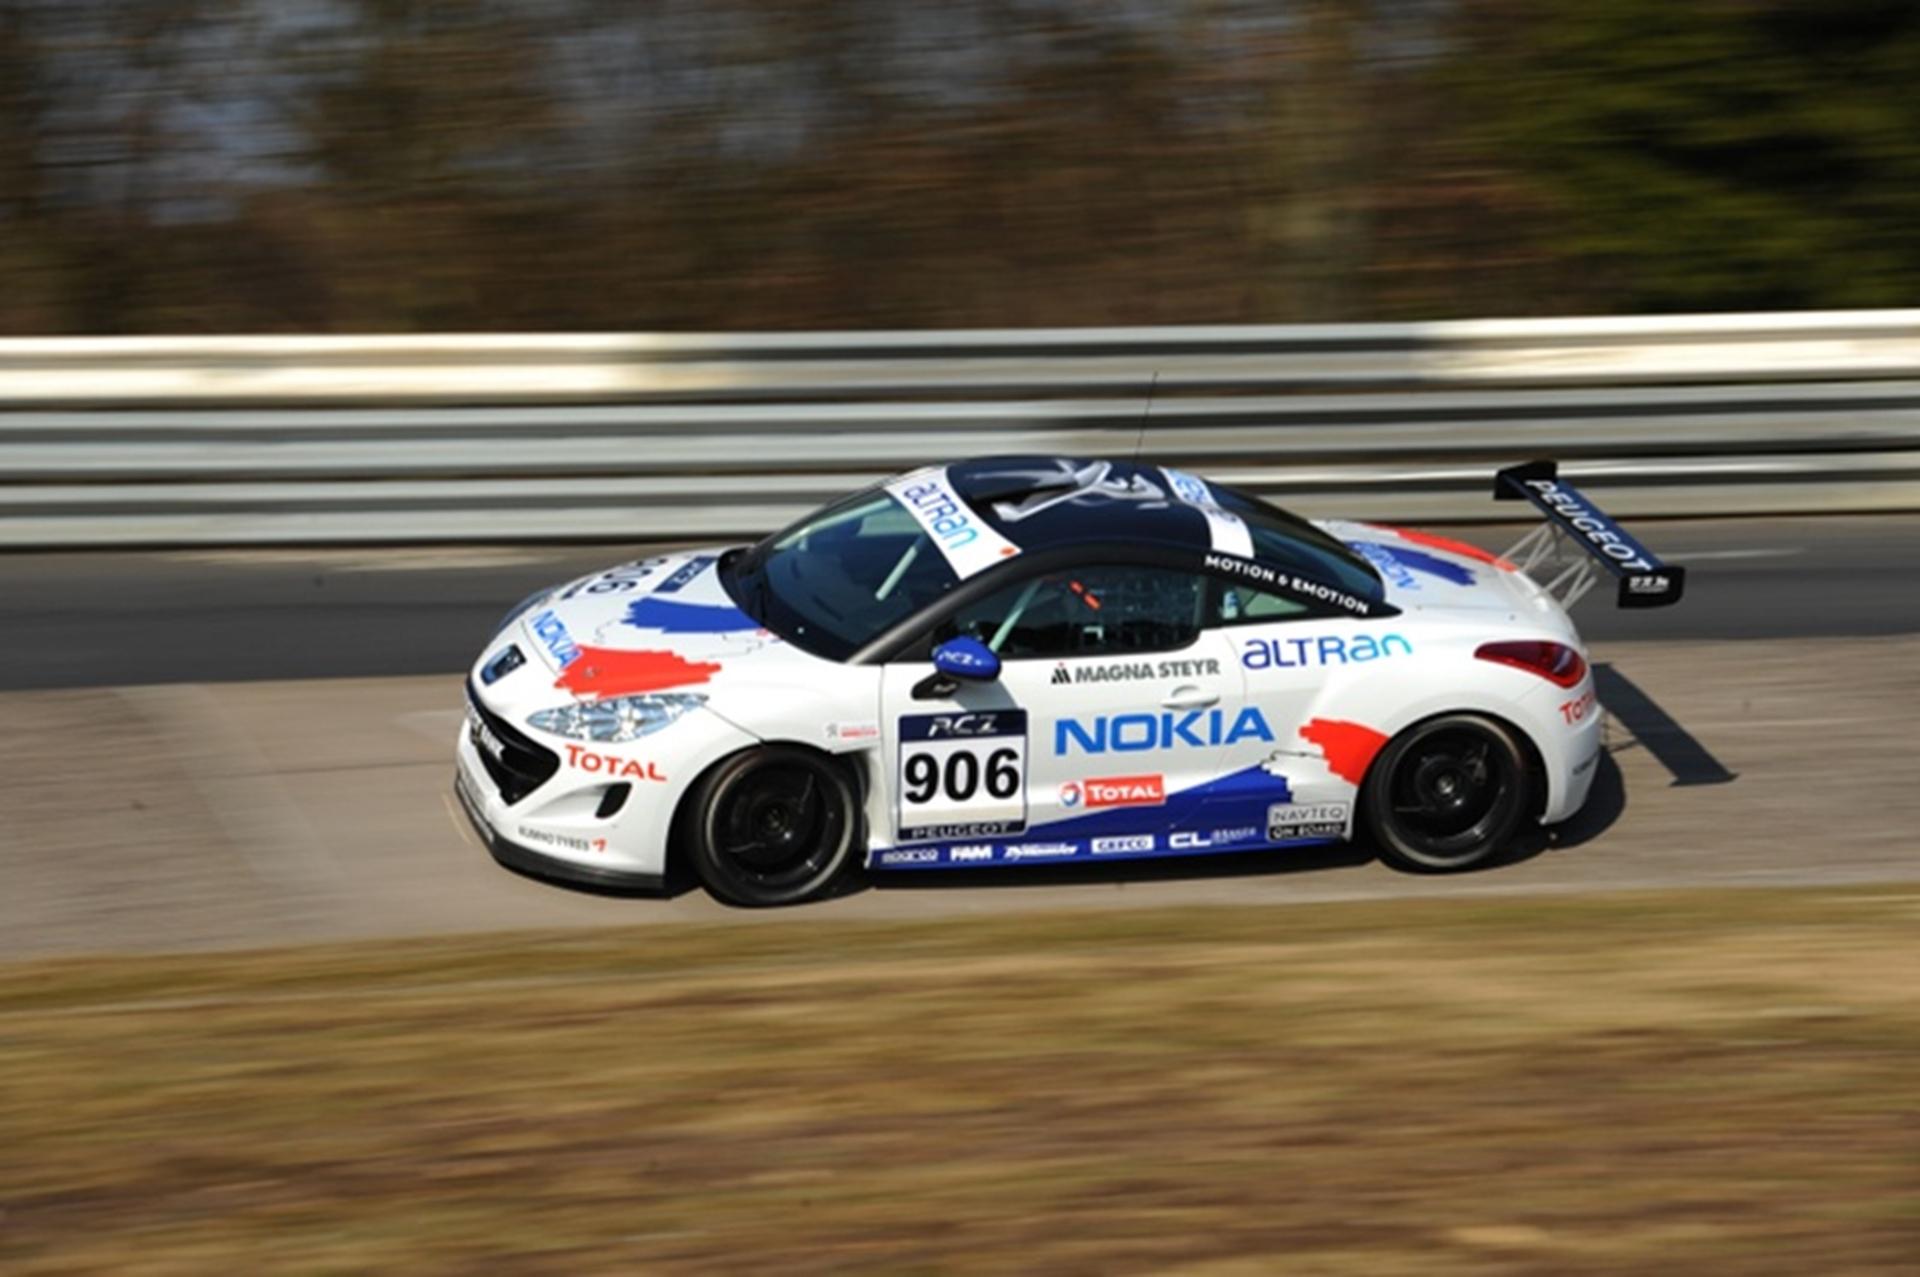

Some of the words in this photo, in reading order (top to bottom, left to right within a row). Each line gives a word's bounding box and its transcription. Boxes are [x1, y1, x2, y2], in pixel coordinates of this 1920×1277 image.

[1525, 480, 1653, 572] PEUGEOT
[1204, 554, 1274, 583] MOTION
[1291, 578, 1369, 615] EMOTION
[531, 609, 583, 669] NOKIA
[1075, 662, 1155, 683] MAGNA
[1158, 658, 1220, 679] STEYR
[928, 715, 998, 737] RCZ
[1055, 706, 1275, 756] NOKIA
[565, 744, 668, 782] TOTAL
[904, 747, 1020, 805] 906
[1088, 780, 1161, 801] TOTAL
[1273, 807, 1344, 823] NAVTEQ
[911, 822, 1012, 839] PEUGEOT
[1169, 832, 1212, 848] CL
[1272, 826, 1295, 838] ON
